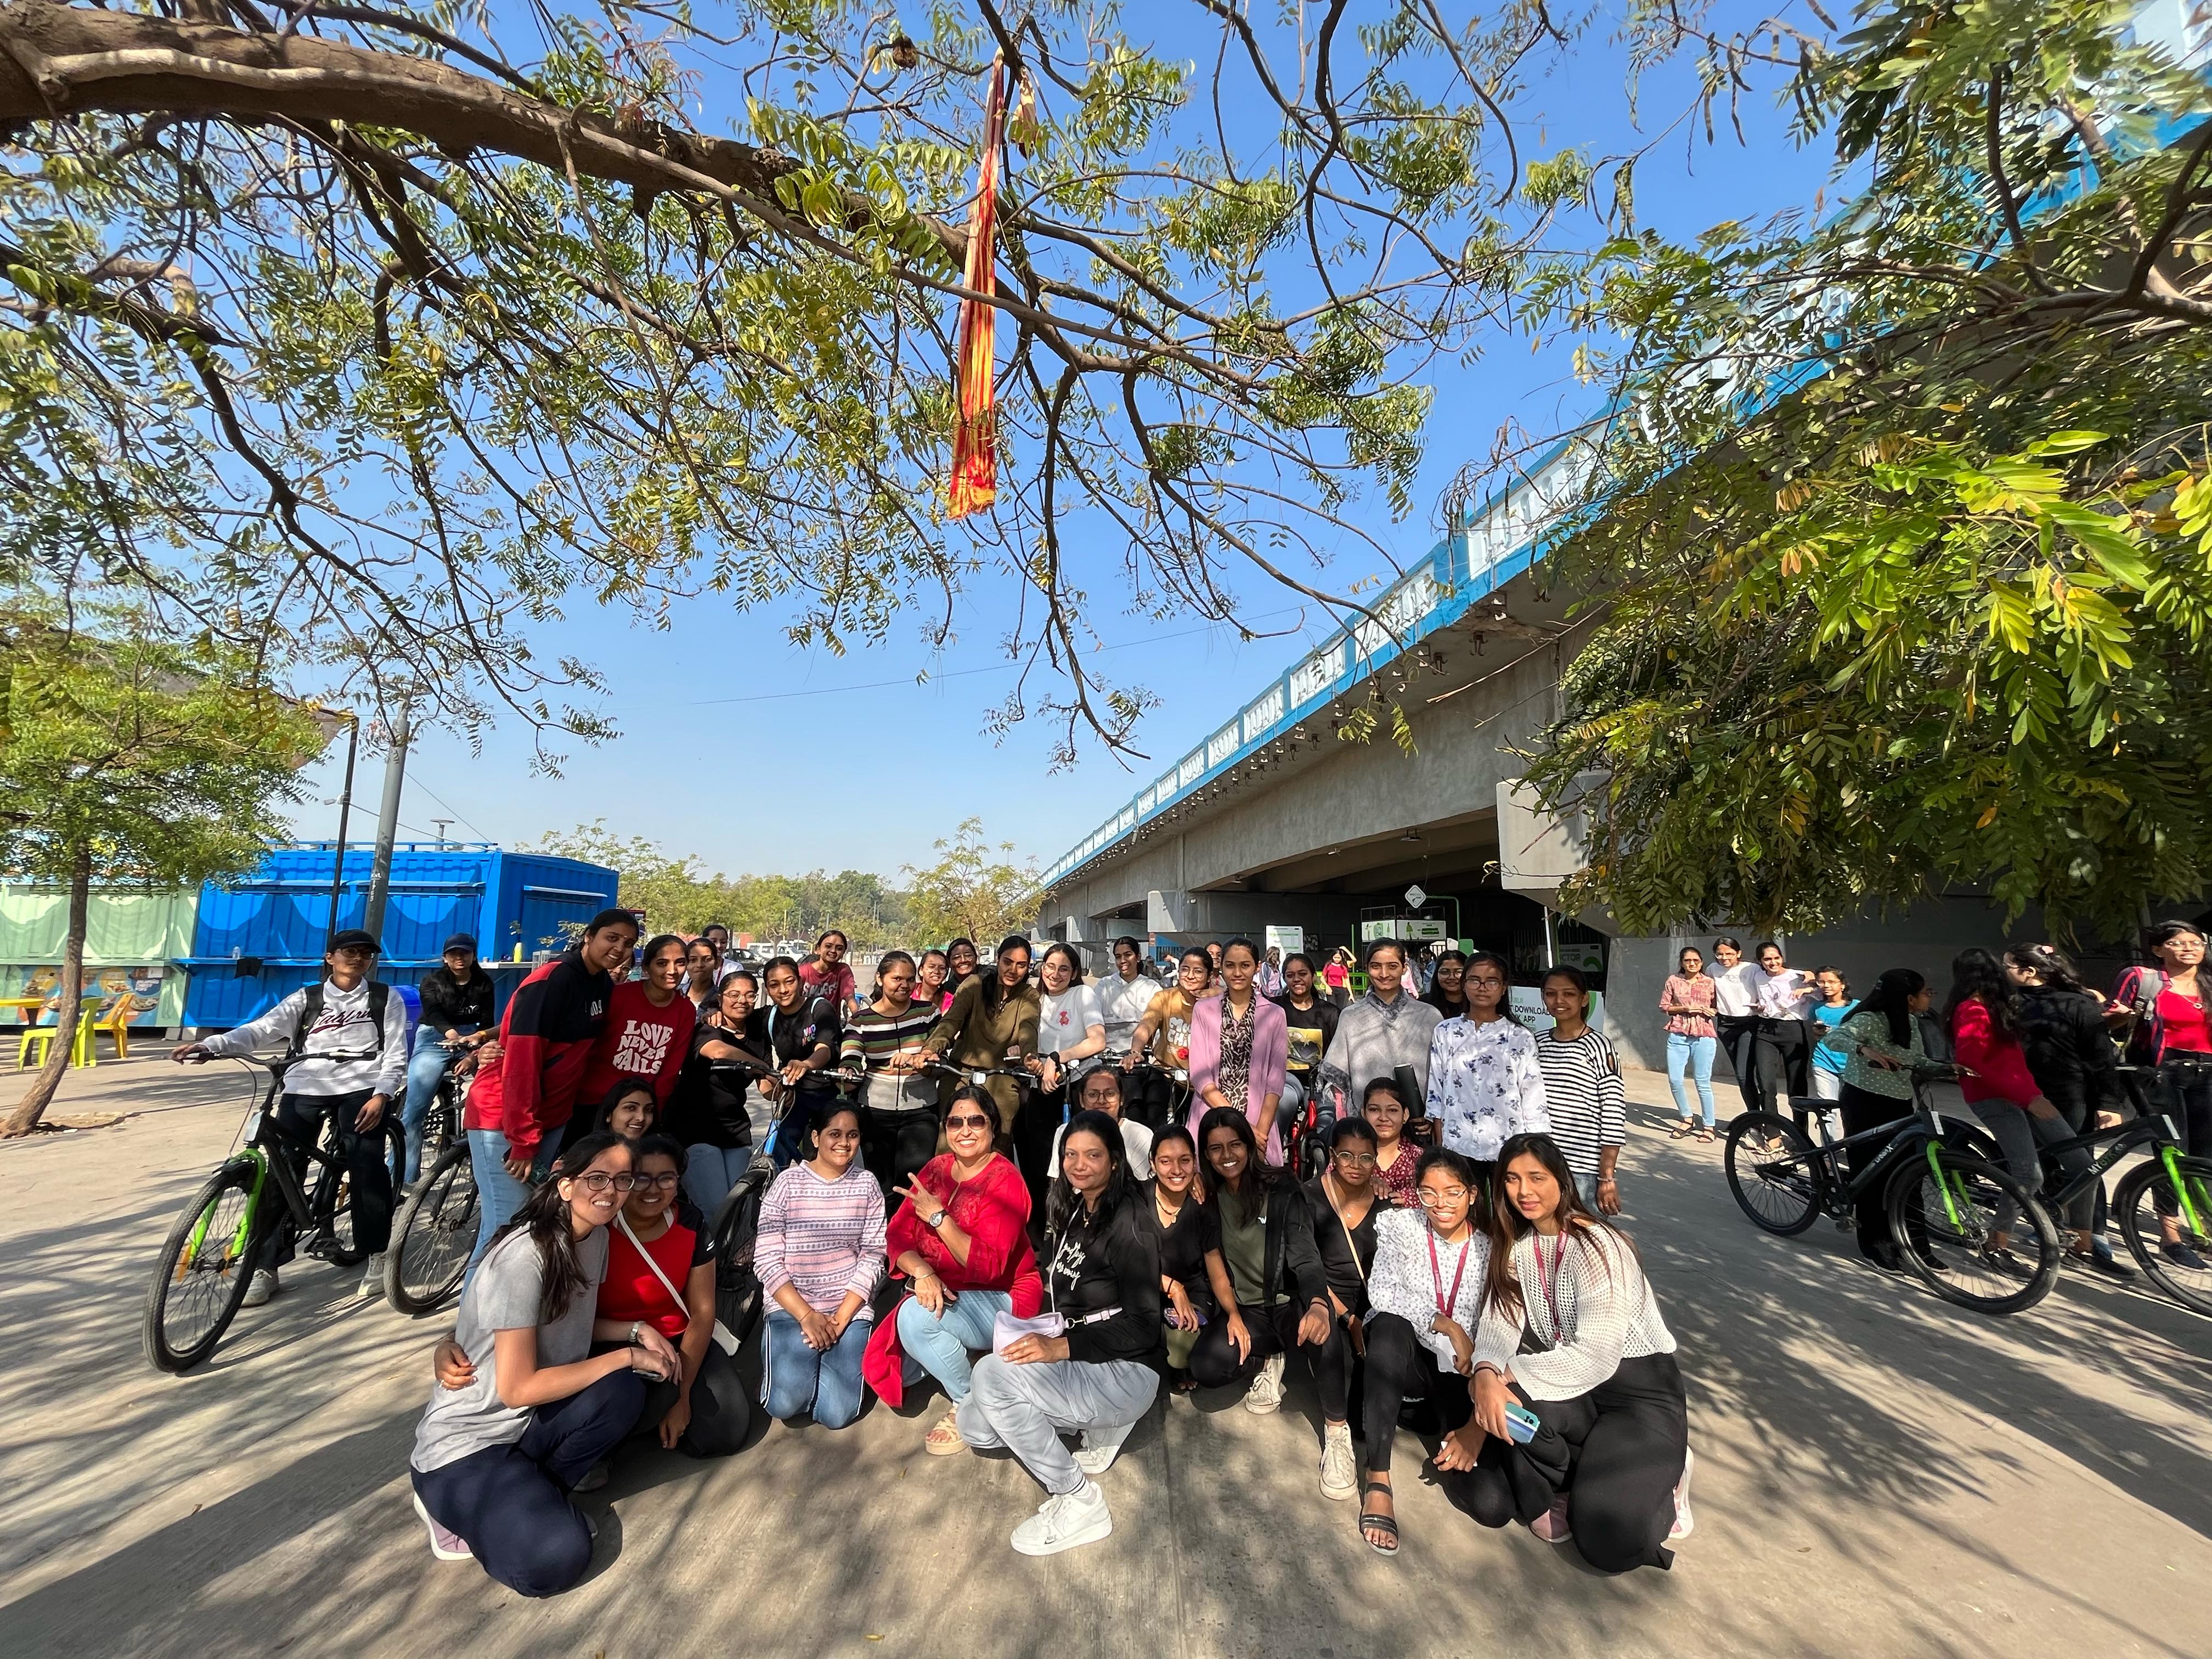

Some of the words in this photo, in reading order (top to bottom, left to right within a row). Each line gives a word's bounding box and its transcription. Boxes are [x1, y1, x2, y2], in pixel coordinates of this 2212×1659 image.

[624, 1020, 673, 1048] LOVE
[617, 1035, 667, 1060] NEVER
[612, 1048, 662, 1074] FAILS
